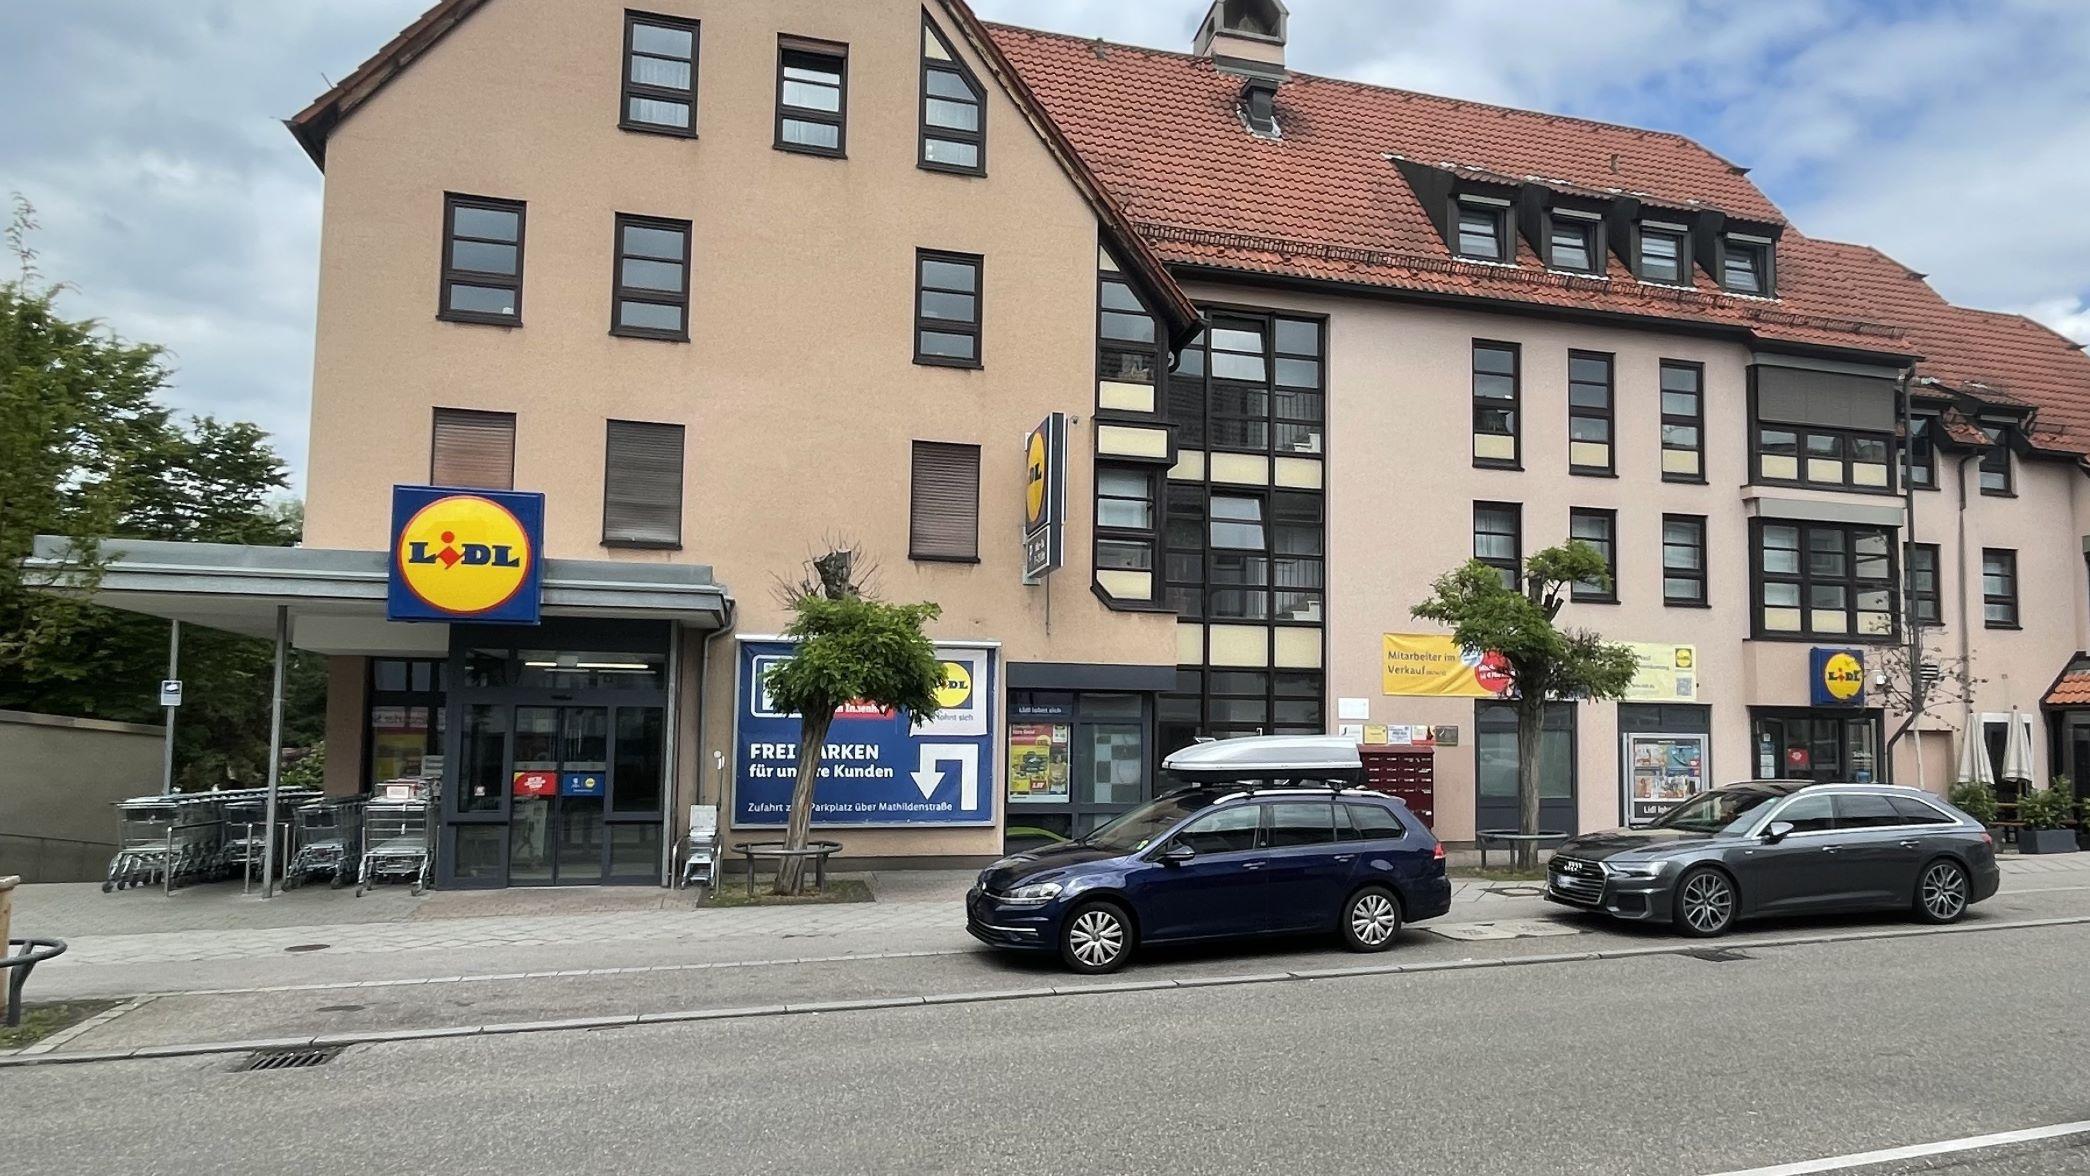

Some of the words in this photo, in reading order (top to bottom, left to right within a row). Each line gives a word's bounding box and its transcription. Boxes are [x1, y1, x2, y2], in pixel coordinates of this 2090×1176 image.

[1387, 651, 1442, 661] Mitarbeiter
[1444, 652, 1455, 661] im
[1387, 665, 1425, 675] Verkauf
[749, 763, 774, 778] für
[776, 766, 830, 778] unre
[833, 764, 894, 778] Kunden
[748, 802, 783, 812] Zufahrt
[810, 802, 853, 813] Parkplatz
[854, 802, 877, 812] über
[879, 801, 953, 812] Mathildenstraße
